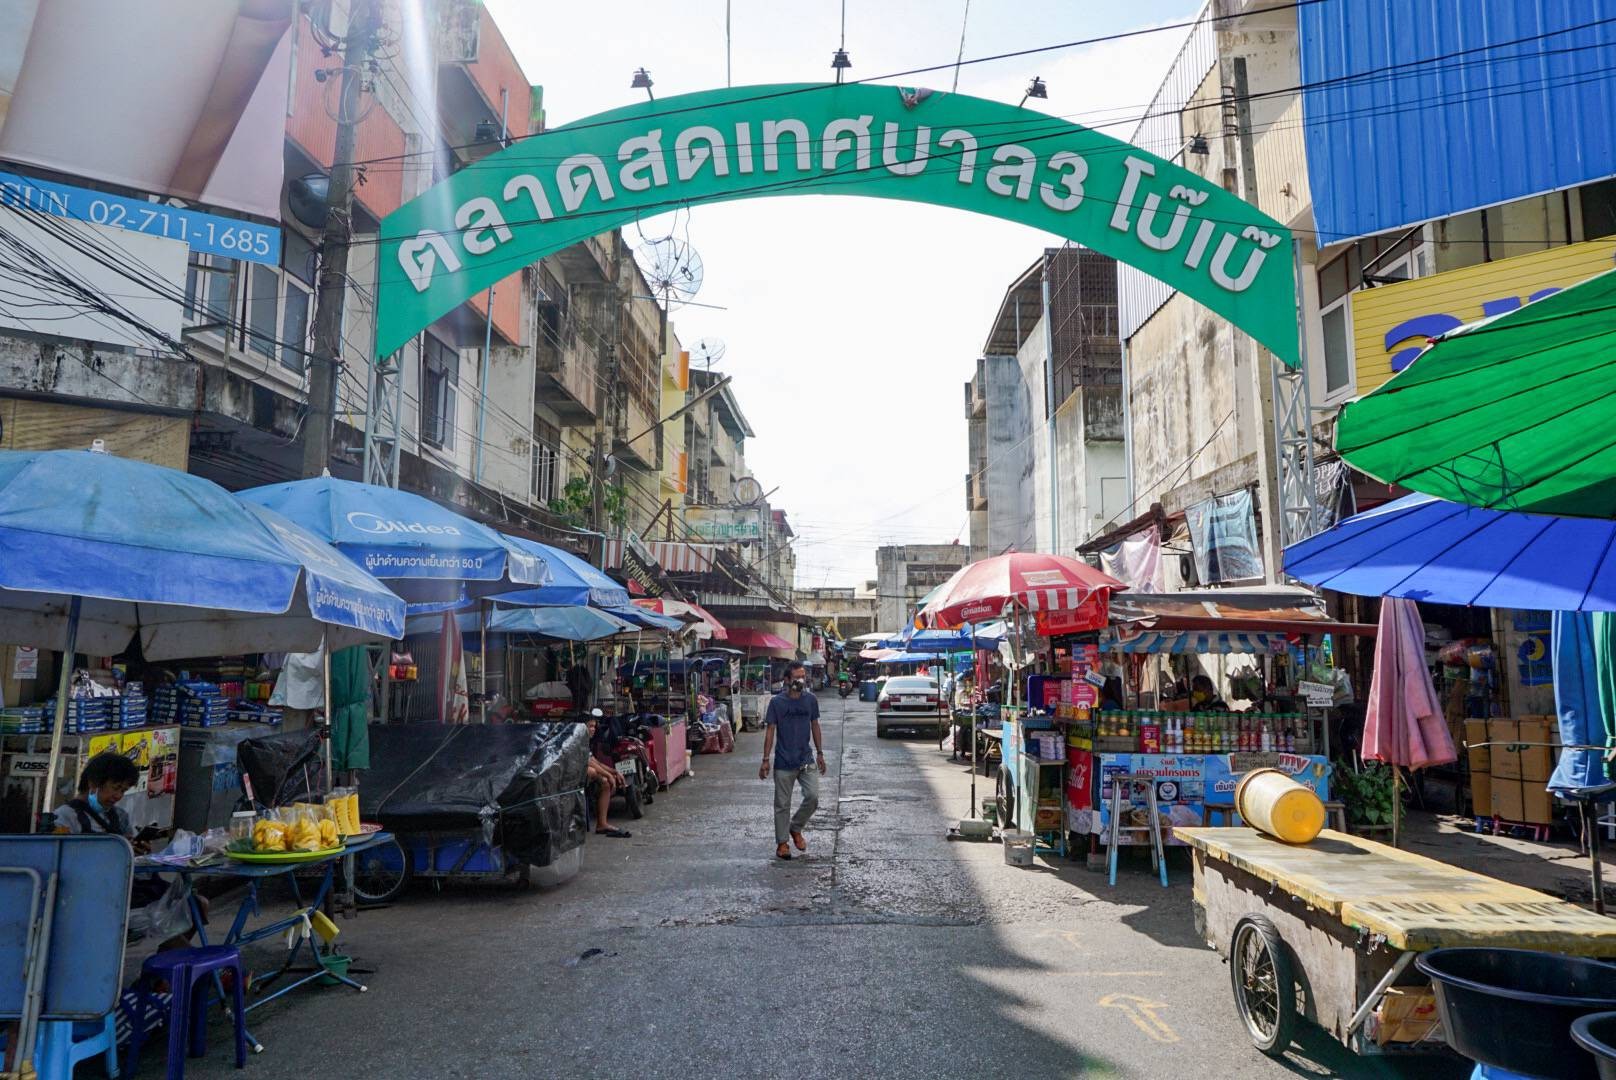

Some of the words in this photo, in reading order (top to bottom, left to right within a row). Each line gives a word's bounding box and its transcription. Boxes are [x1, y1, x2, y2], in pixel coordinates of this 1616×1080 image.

[89, 200, 270, 255] 02-711-1685
[1109, 153, 1283, 293] โบ๊เบ๊
[362, 516, 461, 536] Midea
[365, 553, 460, 570] ผู้นำด้านความเย็นกว่า
[462, 559, 474, 568] 50
[475, 557, 482, 569] ปี
